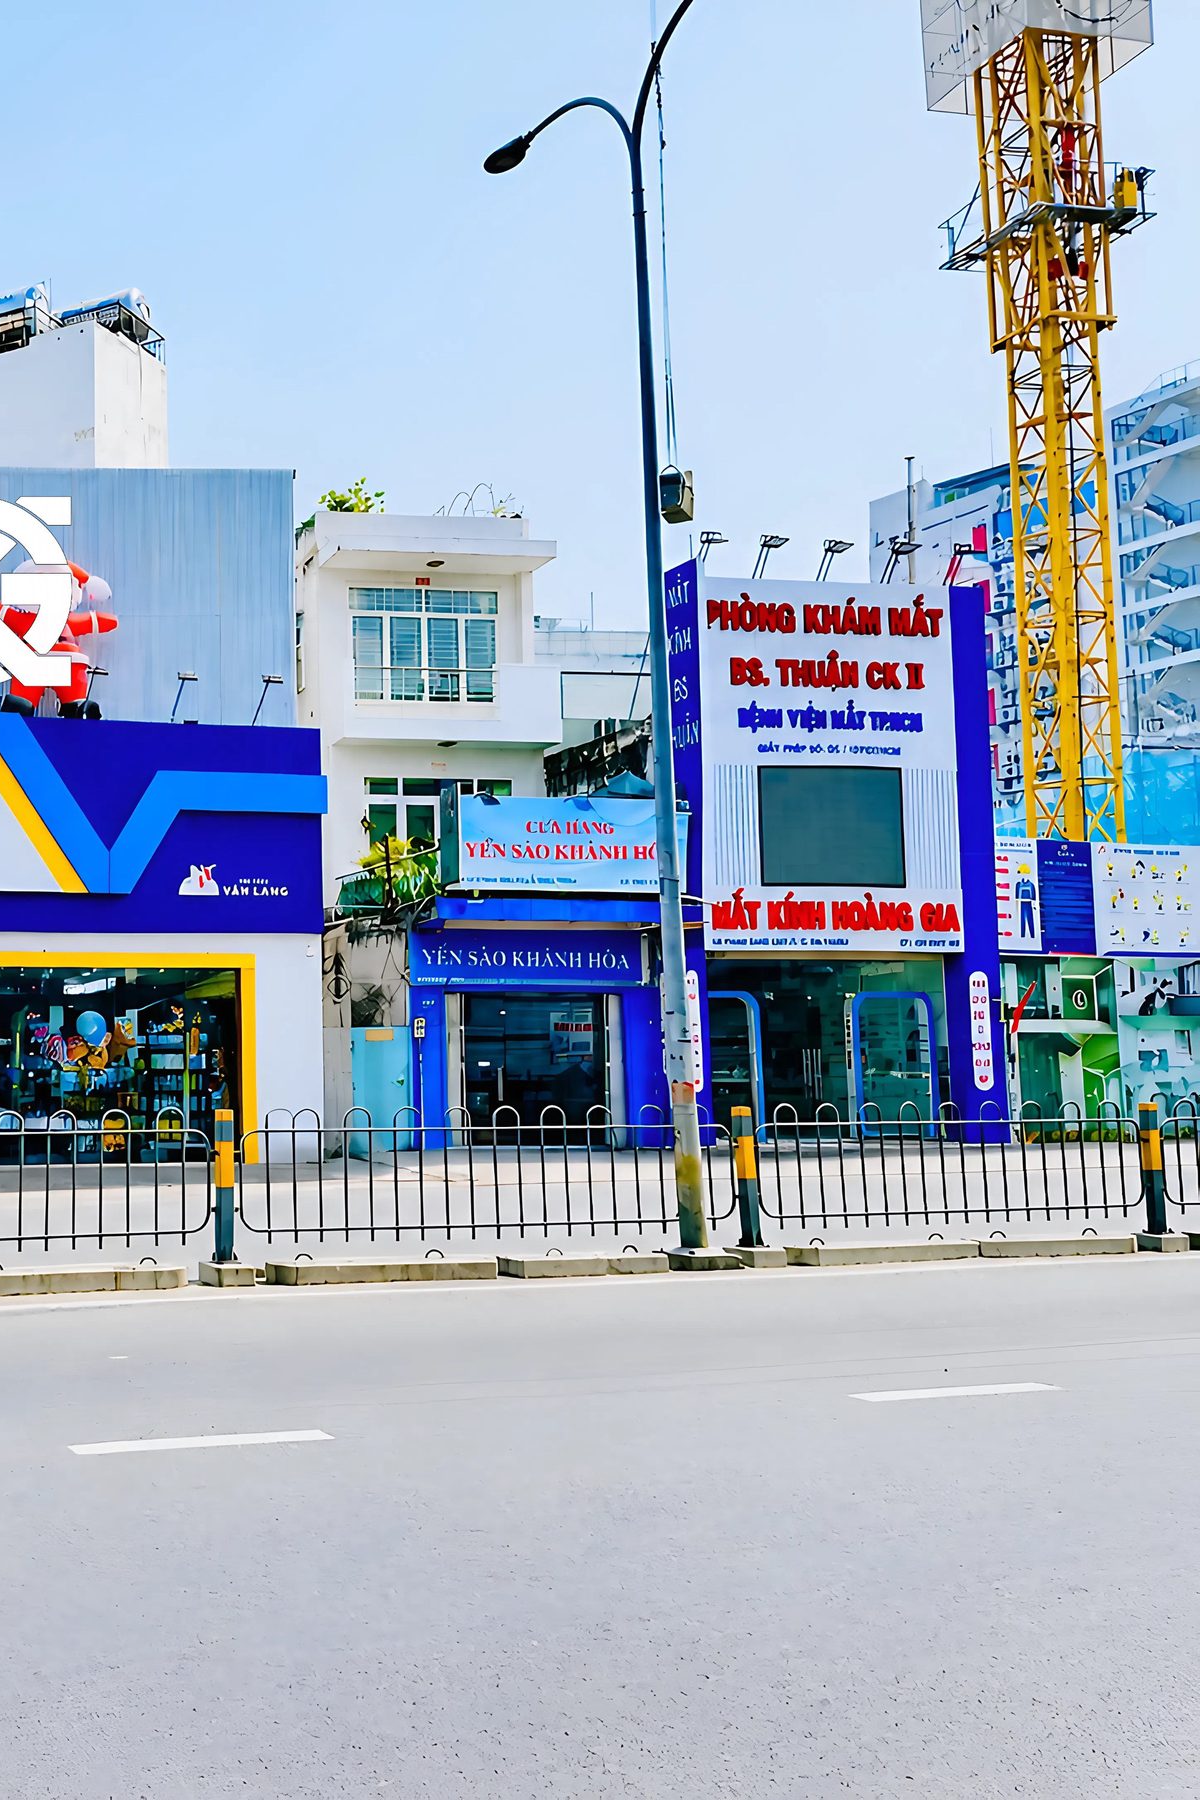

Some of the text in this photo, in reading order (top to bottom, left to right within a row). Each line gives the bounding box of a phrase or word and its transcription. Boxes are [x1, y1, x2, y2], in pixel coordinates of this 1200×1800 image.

[706, 592, 943, 637] PHÒNG KHÁM MẮT
[775, 649, 859, 692] THUẬN
[865, 661, 901, 690] CK
[904, 662, 925, 690] II
[737, 700, 783, 733] BỆNH
[786, 700, 827, 733] VIỆN
[829, 699, 867, 730] MẮT
[711, 887, 961, 932] MẮT KÍNH HOÀNG GIA
